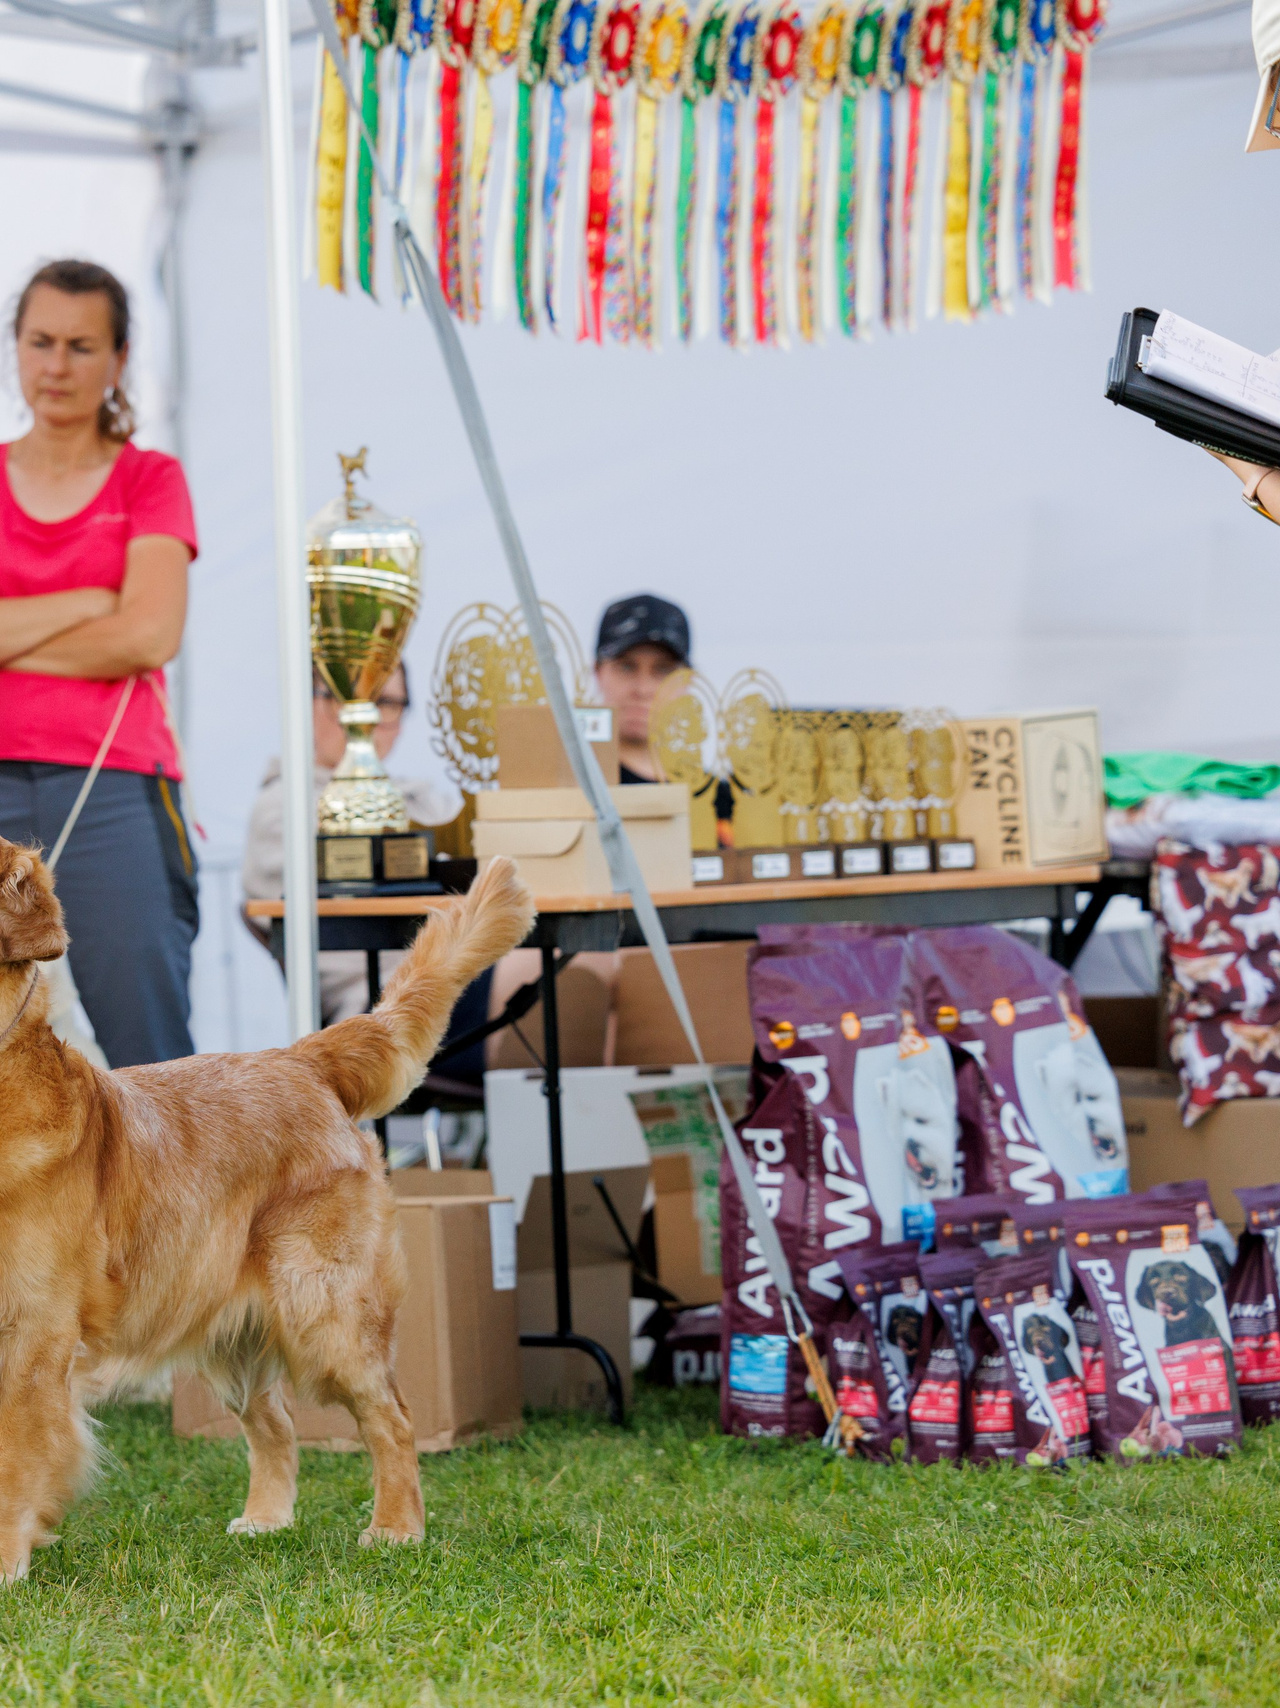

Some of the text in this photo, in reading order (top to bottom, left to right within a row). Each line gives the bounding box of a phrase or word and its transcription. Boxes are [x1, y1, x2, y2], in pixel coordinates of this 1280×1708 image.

[969, 728, 991, 789] FAN
[993, 727, 1023, 863] CYCLINE
[781, 1054, 871, 1301] Awad
[1077, 1258, 1153, 1405] Award
